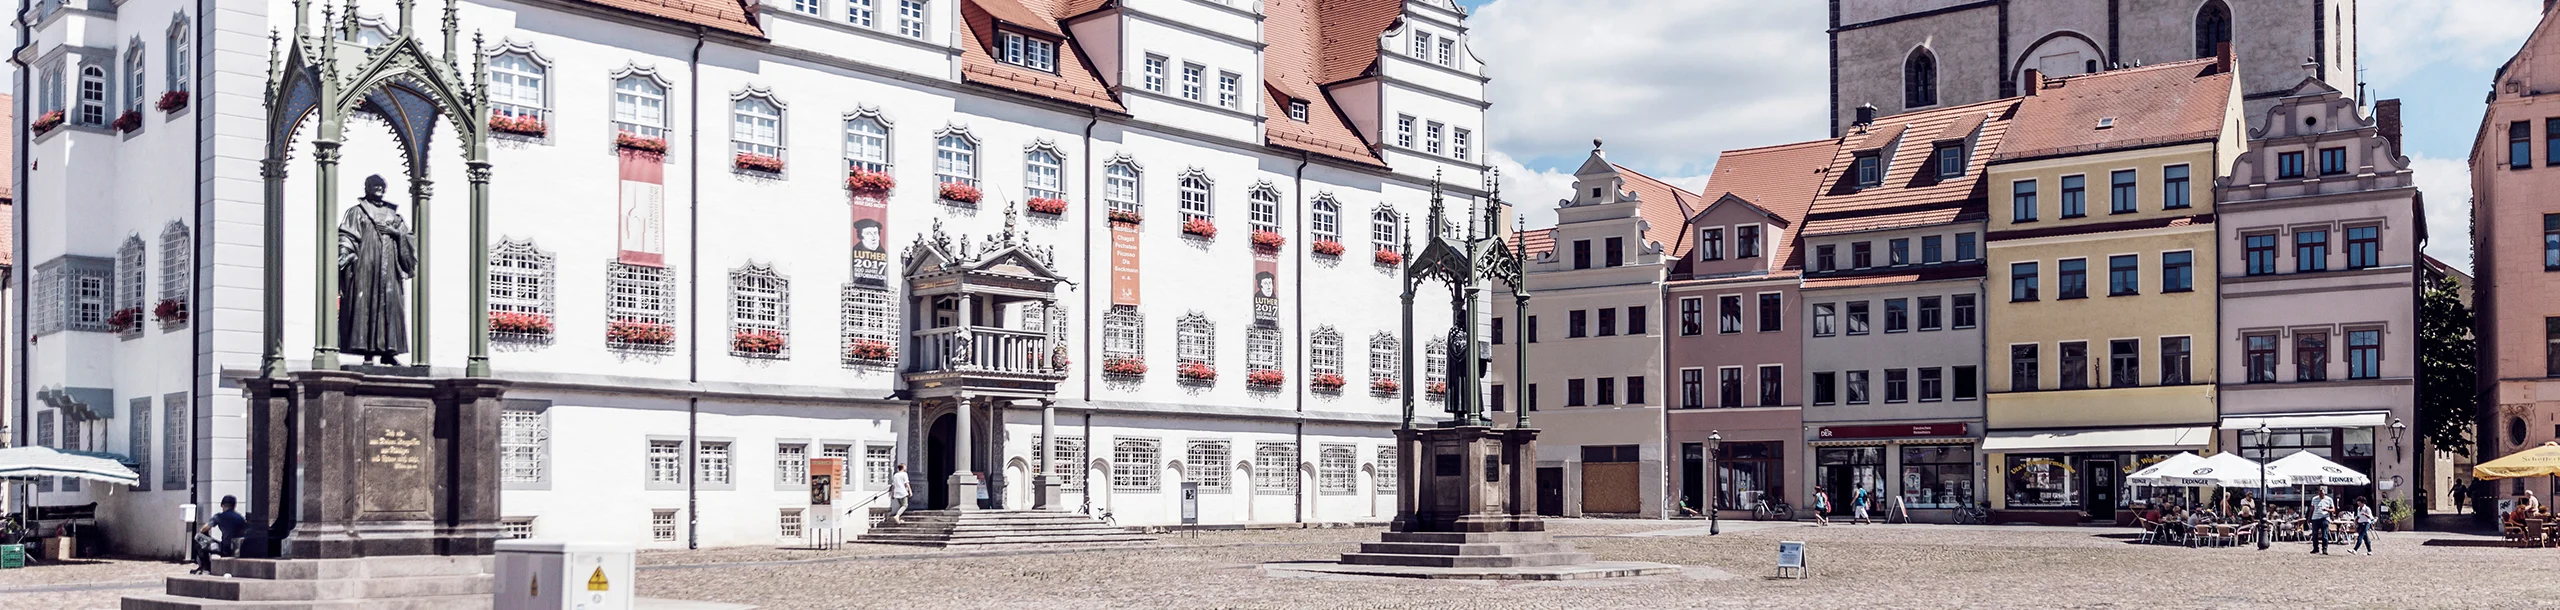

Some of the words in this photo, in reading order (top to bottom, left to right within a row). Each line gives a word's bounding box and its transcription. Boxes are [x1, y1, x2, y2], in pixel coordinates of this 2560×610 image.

[854, 250, 887, 260] LUTHER
[854, 259, 887, 275] 2017
[1255, 297, 1278, 305] LUTHER
[1255, 304, 1278, 316] 2017
